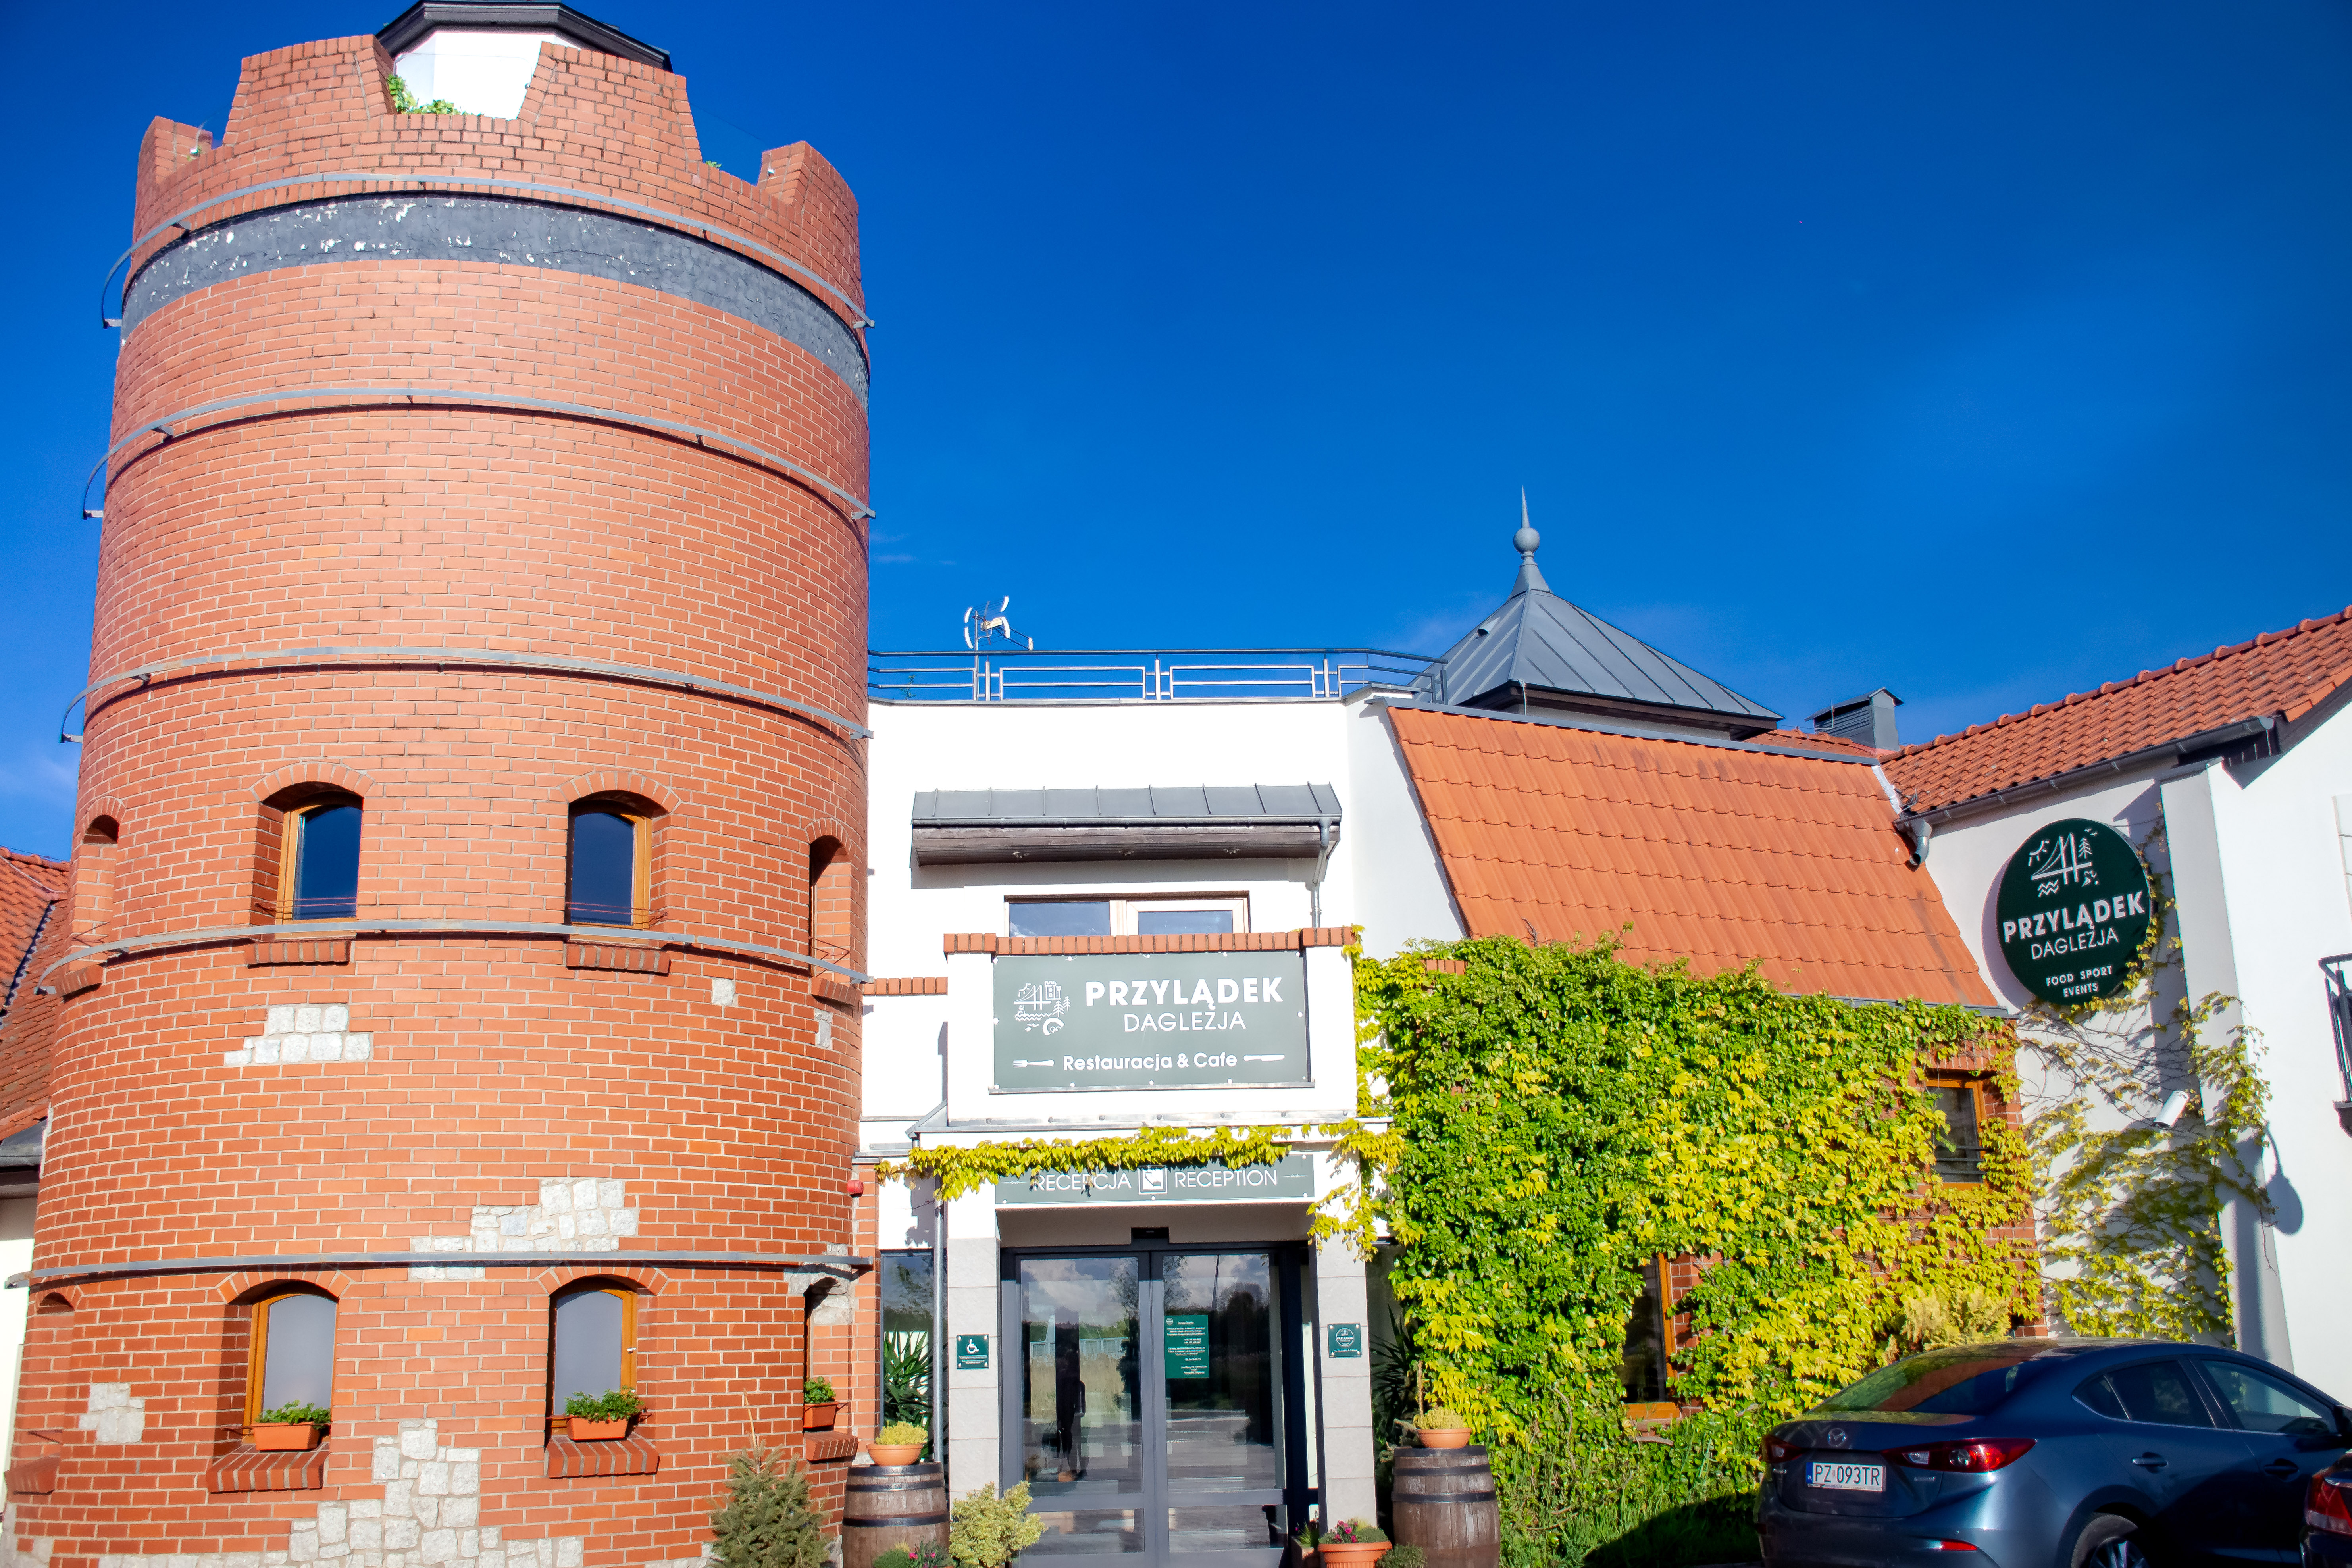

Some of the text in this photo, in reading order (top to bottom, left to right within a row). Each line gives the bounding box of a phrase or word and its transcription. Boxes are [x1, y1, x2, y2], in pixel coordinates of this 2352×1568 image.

[2003, 891, 2145, 943] PRZYLĄDEK
[2031, 927, 2119, 960] DAGLEZJA
[2046, 965, 2113, 987] FOOD SPORT
[1086, 977, 1284, 1010] PRZYLĄDEK
[2063, 982, 2099, 997] EVENTS
[1124, 1011, 1247, 1033] DAGLEZJA
[1063, 1052, 1238, 1072] Restauracja & Cafe
[1174, 1169, 1277, 1188] RECEPTION
[1814, 1464, 1880, 1485] PZ 093TR
